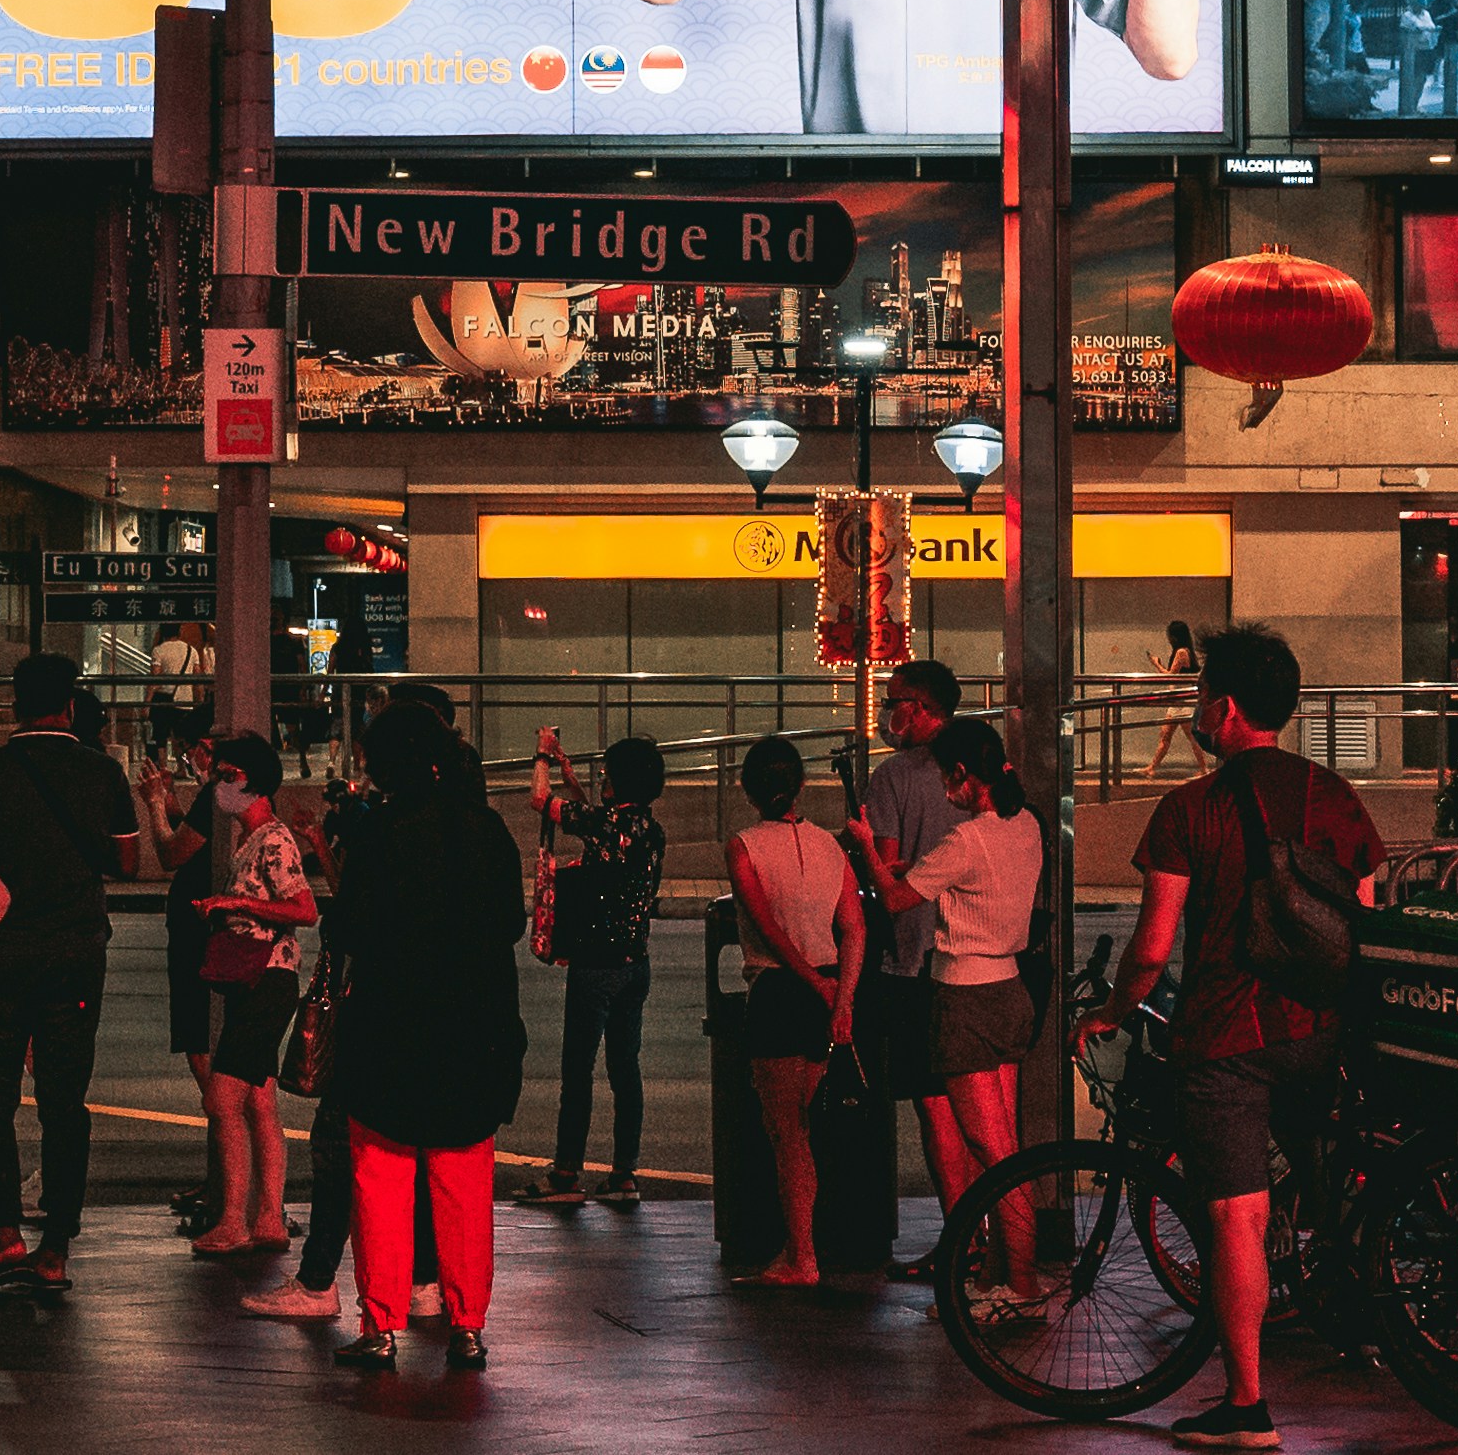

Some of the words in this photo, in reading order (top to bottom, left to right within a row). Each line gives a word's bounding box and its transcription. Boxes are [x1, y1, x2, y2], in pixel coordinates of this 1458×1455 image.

[317, 50, 513, 86] countries
[46, 105, 61, 114] and
[62, 105, 101, 114] Conditions
[125, 104, 138, 113] For
[138, 104, 151, 112] full
[1227, 159, 1274, 173] FALCON
[1276, 159, 1313, 173] MEDIA
[326, 204, 457, 254] New
[491, 206, 708, 272] Bridge
[741, 212, 815, 263] Rd
[463, 314, 595, 338] FALCON
[613, 314, 718, 338] MEDIA
[978, 335, 1003, 348] FO
[1084, 335, 1166, 350] ENQUIRIES,
[613, 350, 653, 362] VISION
[1072, 353, 1121, 366] NTACT
[1124, 353, 1144, 366] US
[1149, 353, 1167, 366] AT
[225, 362, 265, 377] 120m
[1091, 371, 1125, 384] 6911
[1131, 371, 1166, 384] 5033
[230, 381, 259, 395] Taxi
[52, 556, 80, 576] Eu
[94, 556, 152, 582] Tong
[165, 557, 209, 577] Sen
[91, 598, 211, 617] 余东旋街
